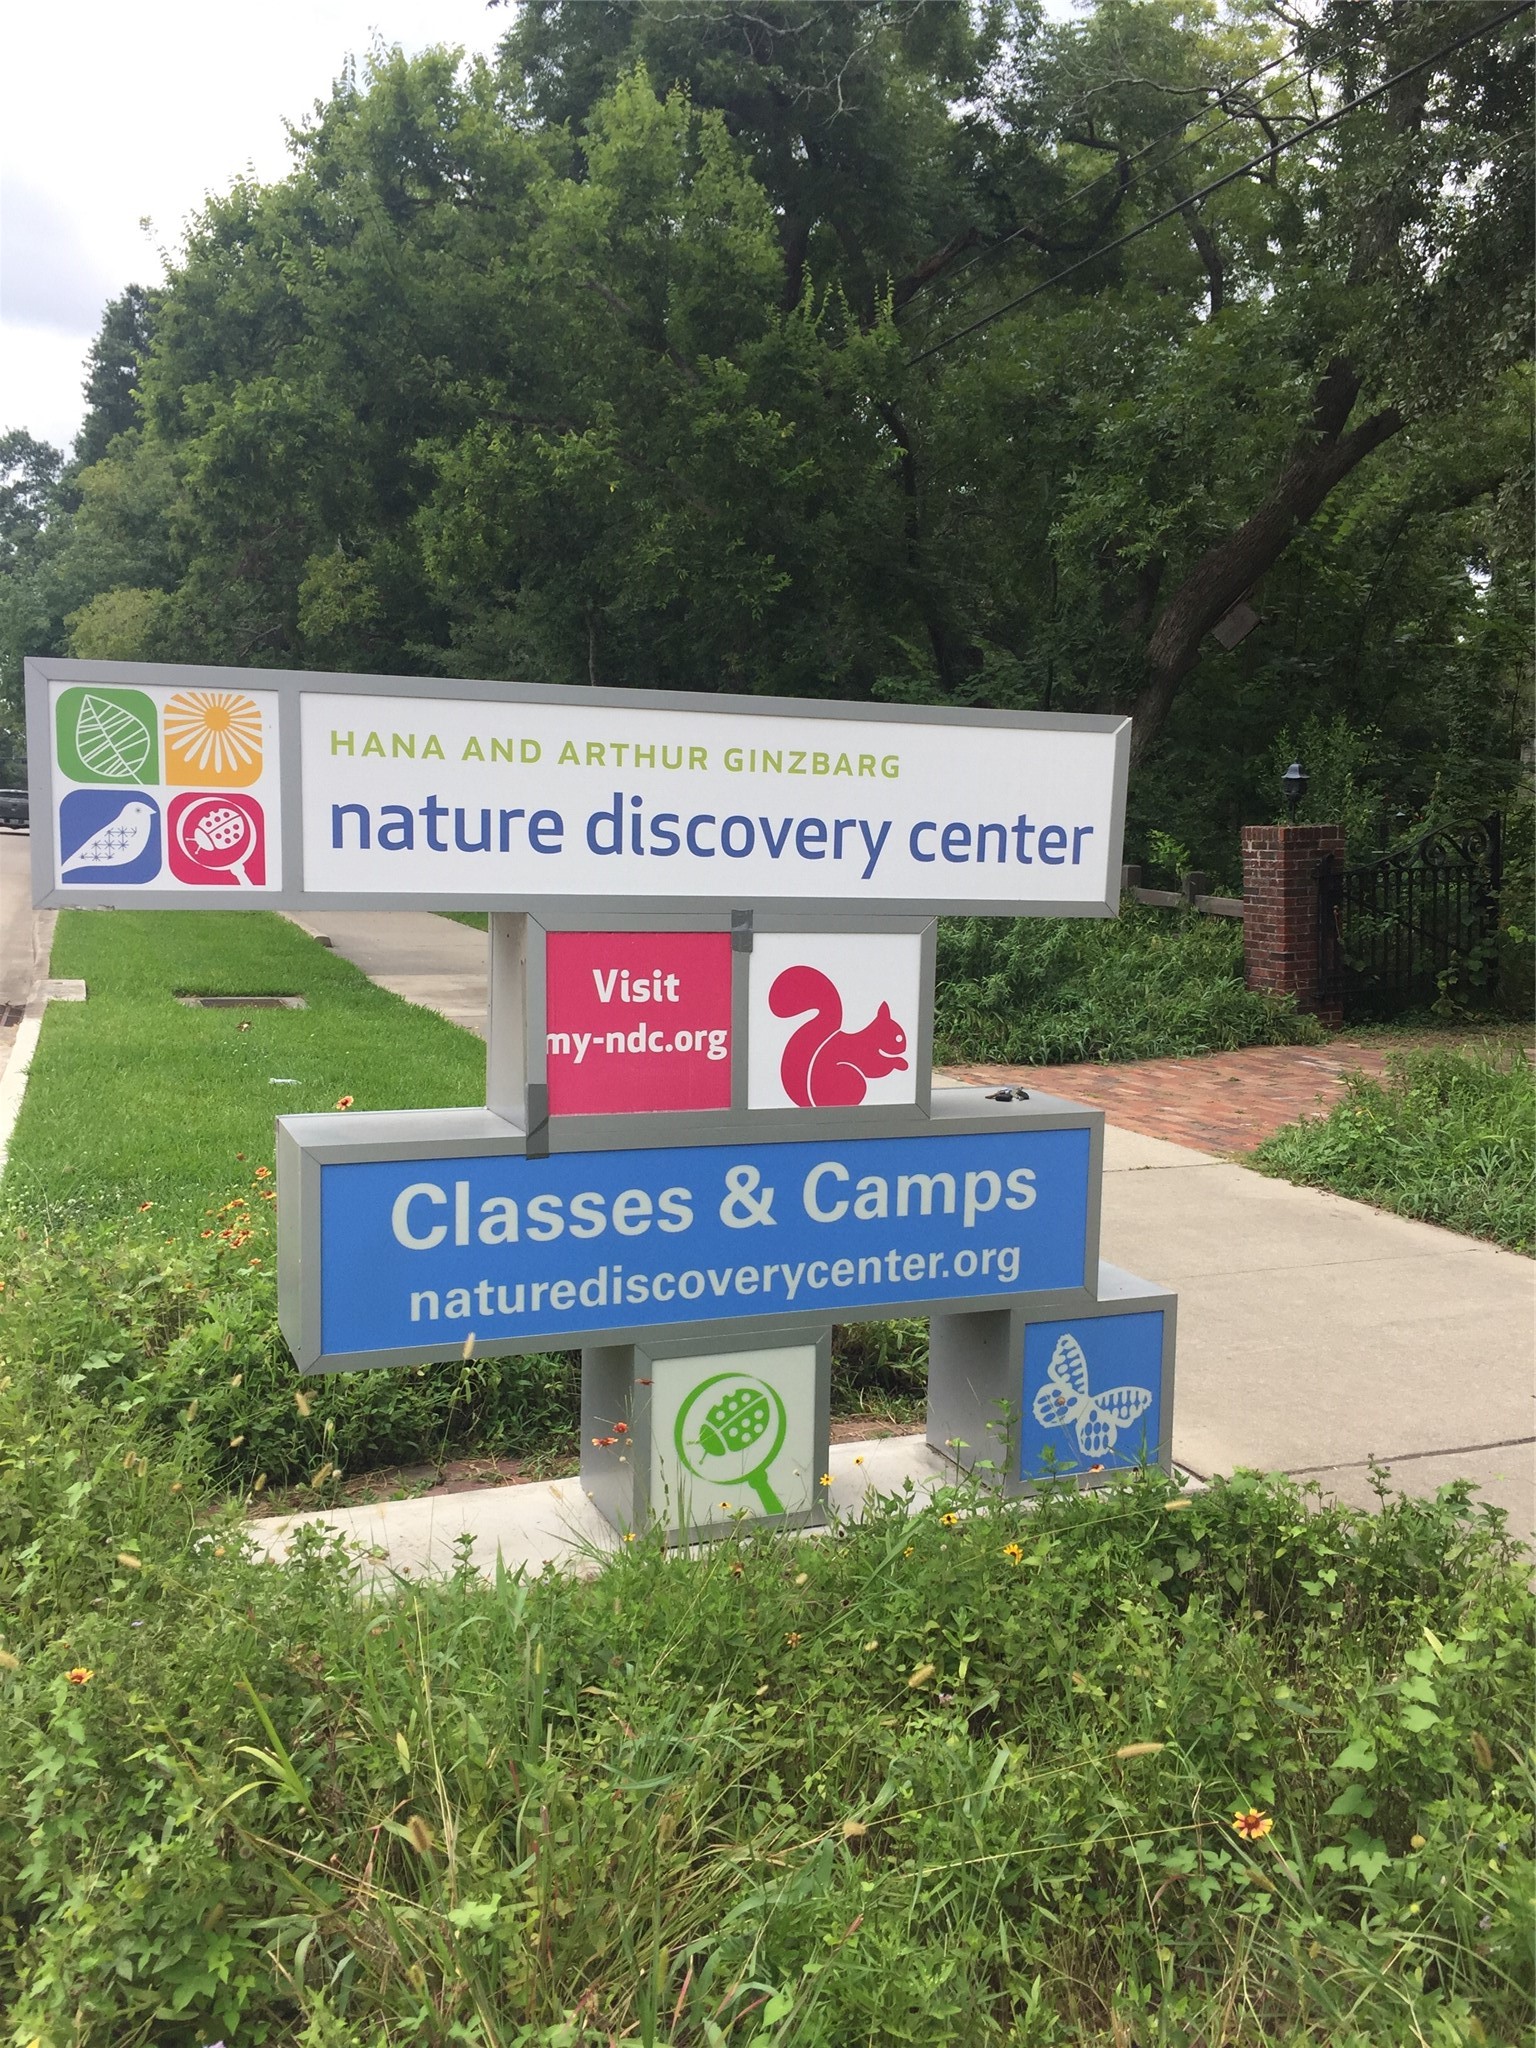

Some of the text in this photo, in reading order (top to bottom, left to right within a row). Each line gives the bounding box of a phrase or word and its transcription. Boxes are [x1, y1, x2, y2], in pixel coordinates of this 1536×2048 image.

[330, 731, 901, 780] HANA AND ARTHUR GINZBARG
[330, 790, 1095, 880] nature discovery center
[592, 968, 681, 1004] Visit
[546, 1022, 728, 1065] my-ndc.org
[390, 1160, 1039, 1251] Classes & Camps
[409, 1246, 1021, 1323] naturediscoverycenter.org
